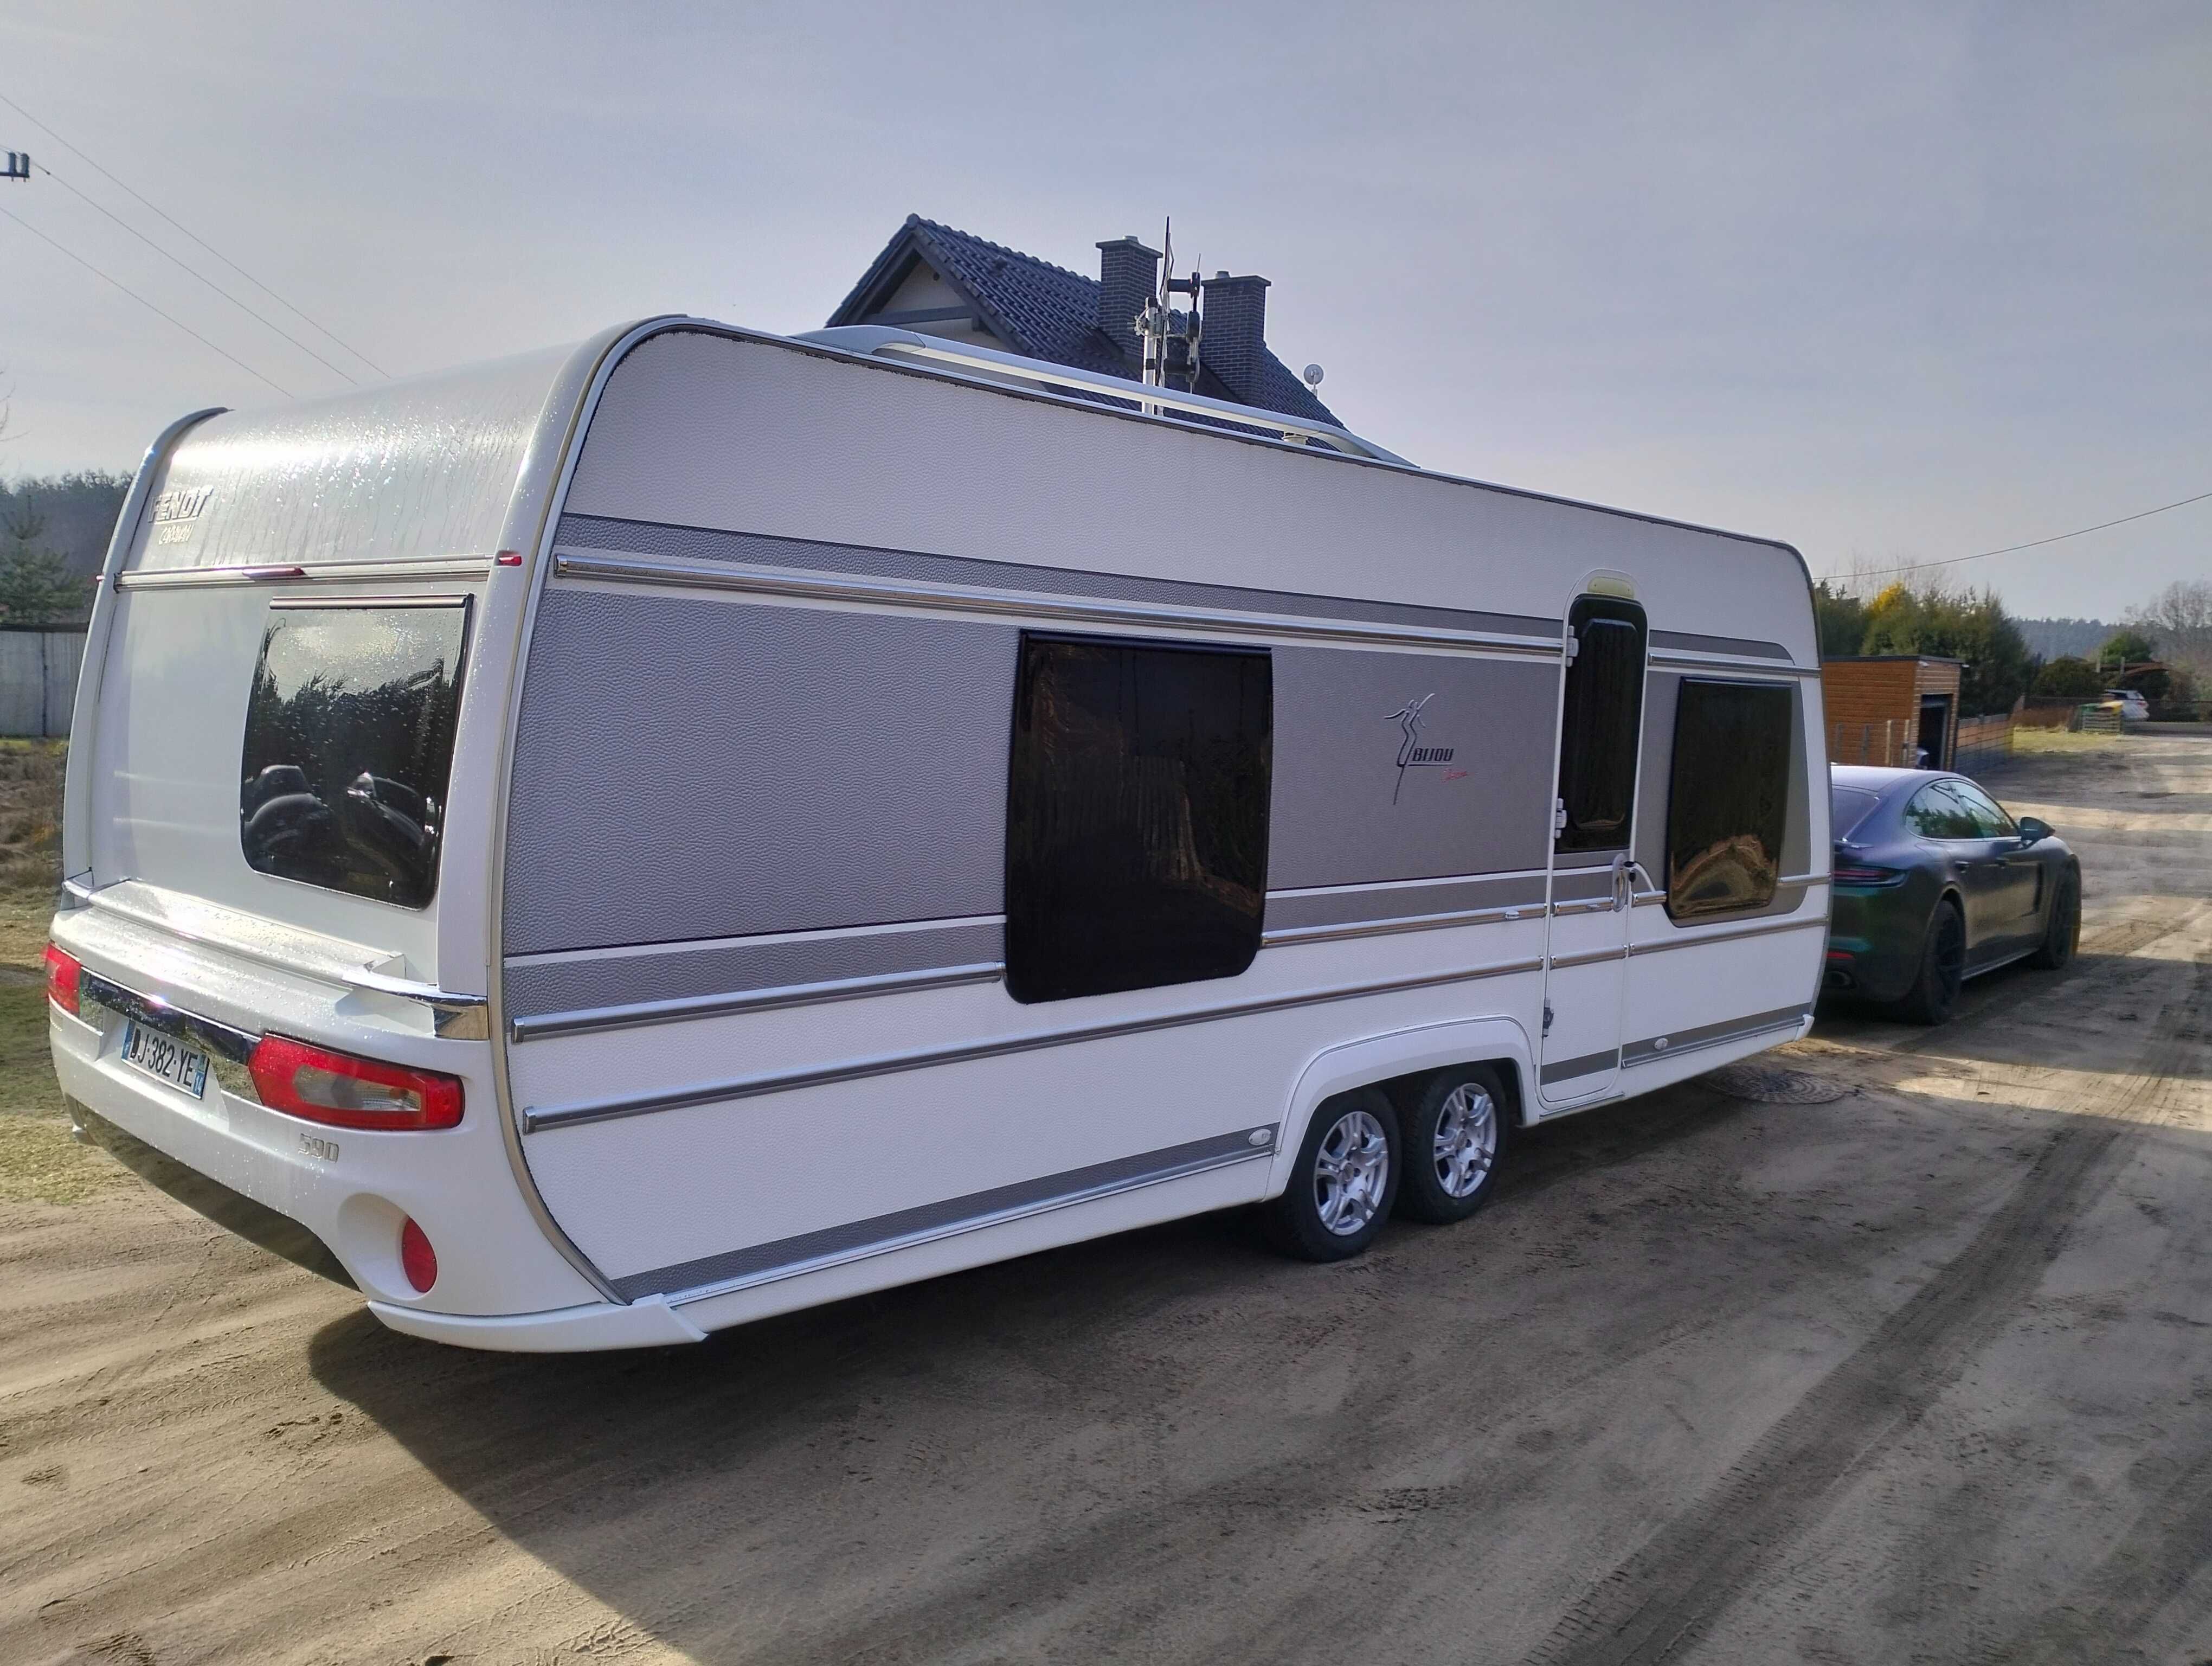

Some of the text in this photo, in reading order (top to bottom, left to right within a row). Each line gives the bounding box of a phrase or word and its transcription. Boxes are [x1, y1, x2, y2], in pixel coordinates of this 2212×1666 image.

[148, 485, 213, 522] FENDT
[1413, 748, 1454, 761] BIJOU
[298, 1133, 339, 1163] 590
